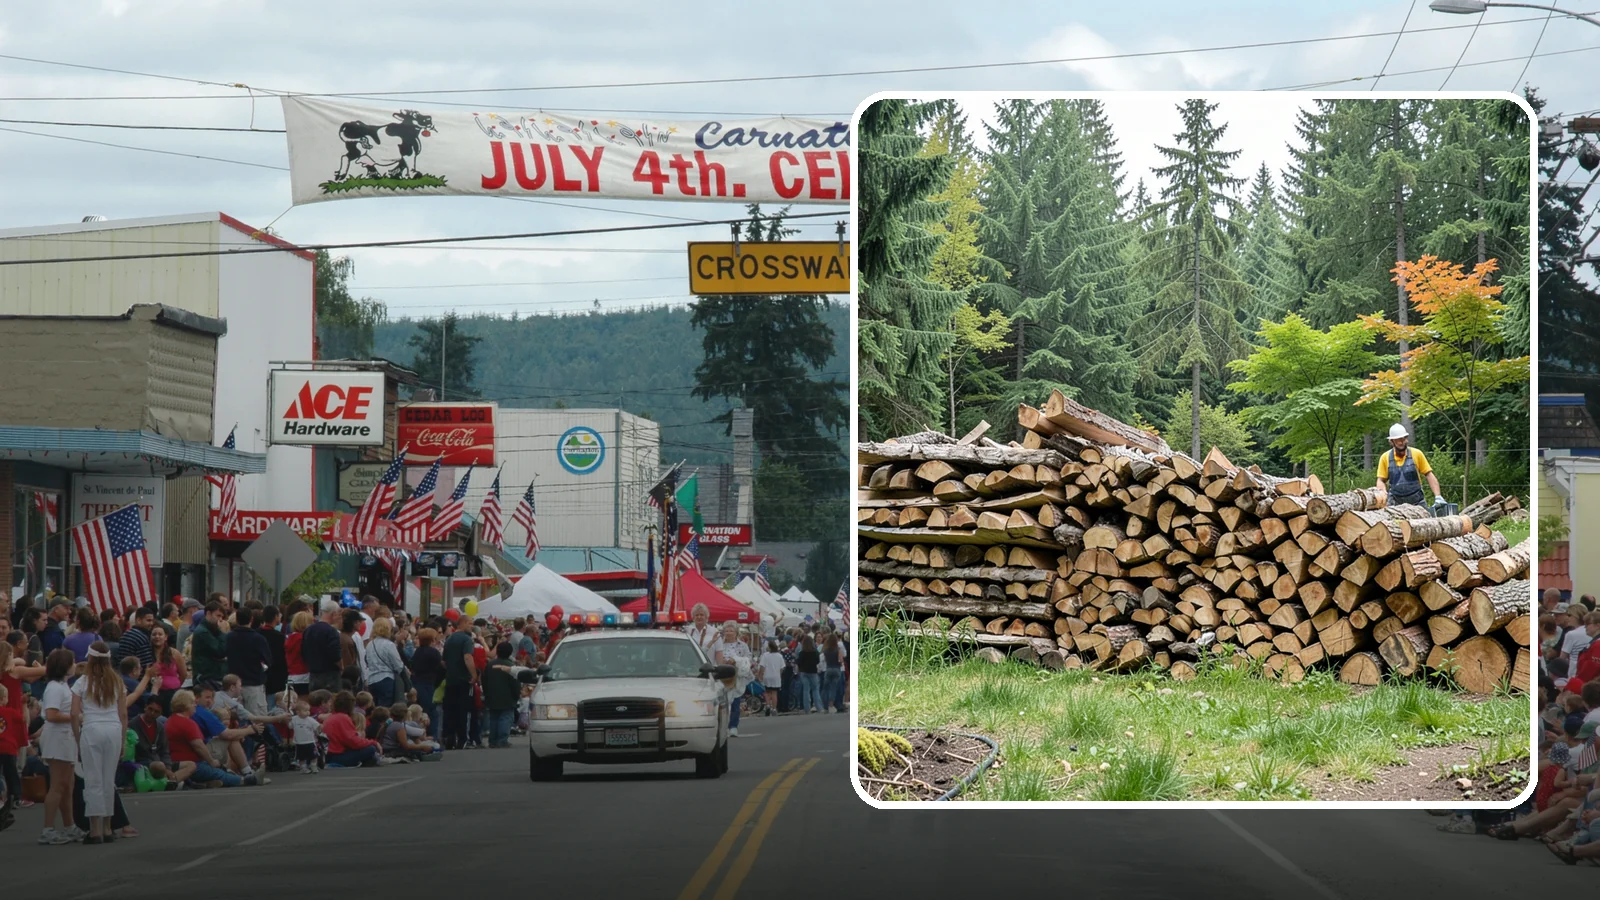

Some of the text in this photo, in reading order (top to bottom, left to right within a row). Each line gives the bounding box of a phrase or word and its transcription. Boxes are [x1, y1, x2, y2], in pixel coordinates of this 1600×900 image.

[481, 140, 605, 192] JULY
[632, 150, 746, 198] 4th.
[697, 254, 850, 280] CROSSWA
[282, 379, 374, 420] ACE
[405, 409, 453, 423] CEDAR
[283, 421, 371, 437] Hardware
[416, 428, 477, 447] Coca-Cola
[353, 467, 386, 480] Simpl
[95, 484, 125, 495] Vincent
[126, 485, 136, 495] de
[137, 485, 155, 496] Paul
[688, 526, 742, 535] CRNATION
[698, 535, 731, 543] GLASS
